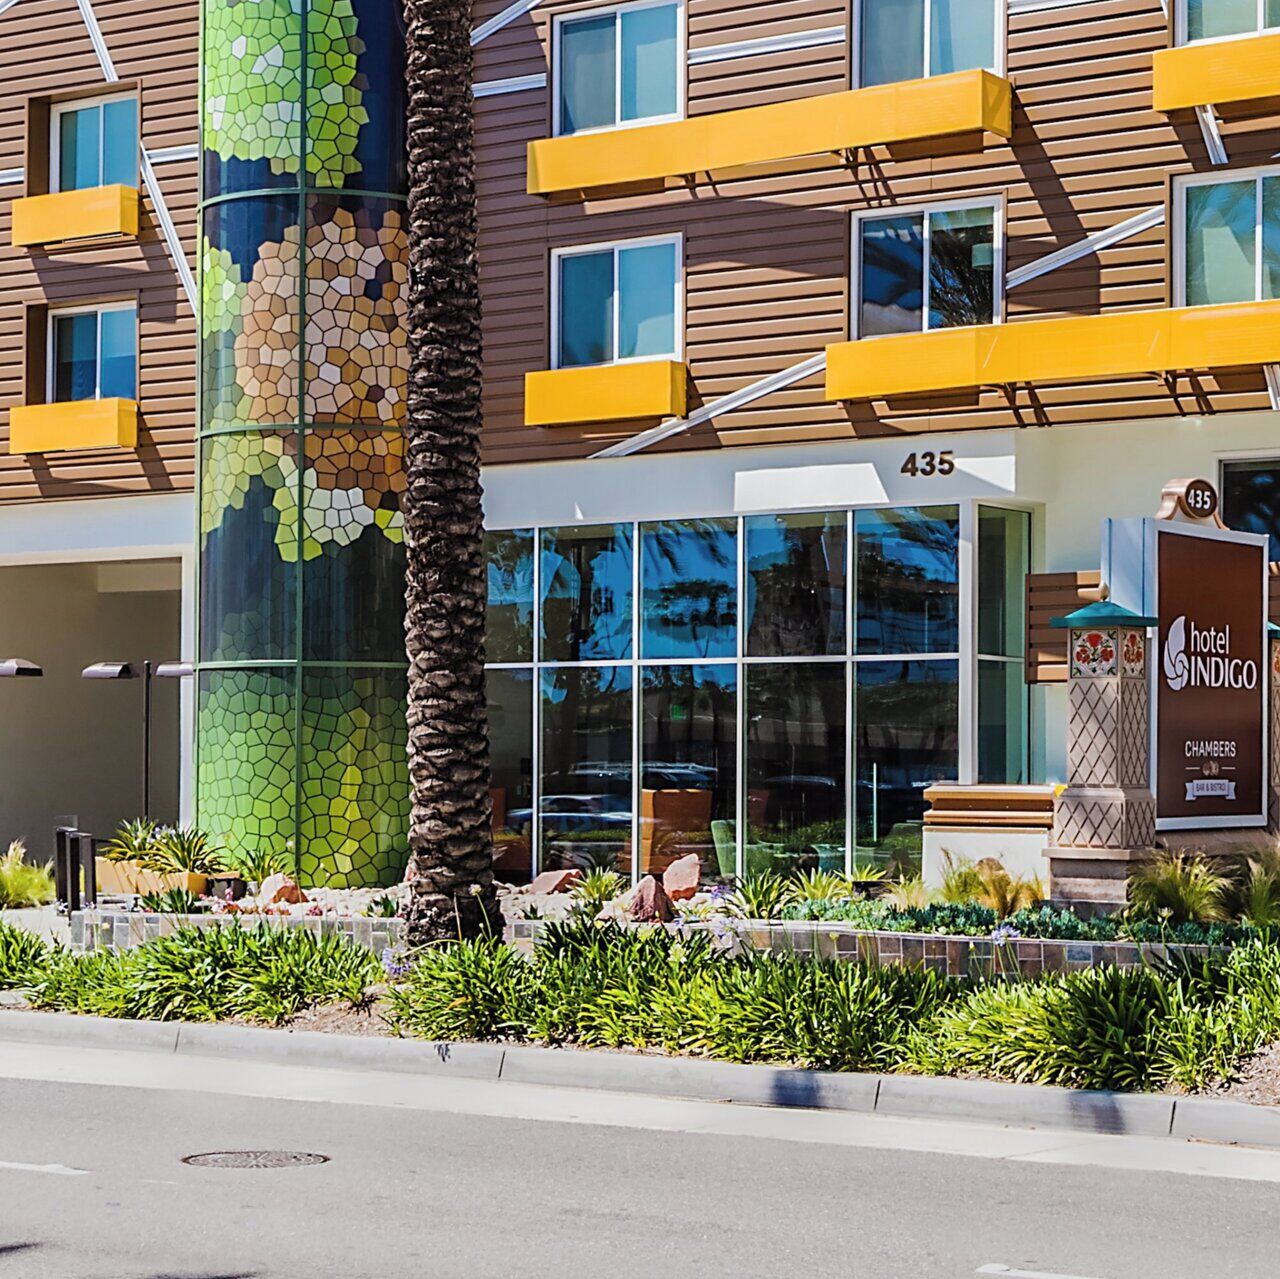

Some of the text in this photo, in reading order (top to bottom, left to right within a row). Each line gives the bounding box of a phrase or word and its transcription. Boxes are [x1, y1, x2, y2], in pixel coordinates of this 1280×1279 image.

[900, 450, 955, 477] 435
[1187, 488, 1211, 510] 435
[1190, 621, 1230, 655] hotel
[1190, 655, 1257, 690] INDIGO
[1185, 740, 1236, 757] CHAMBERS
